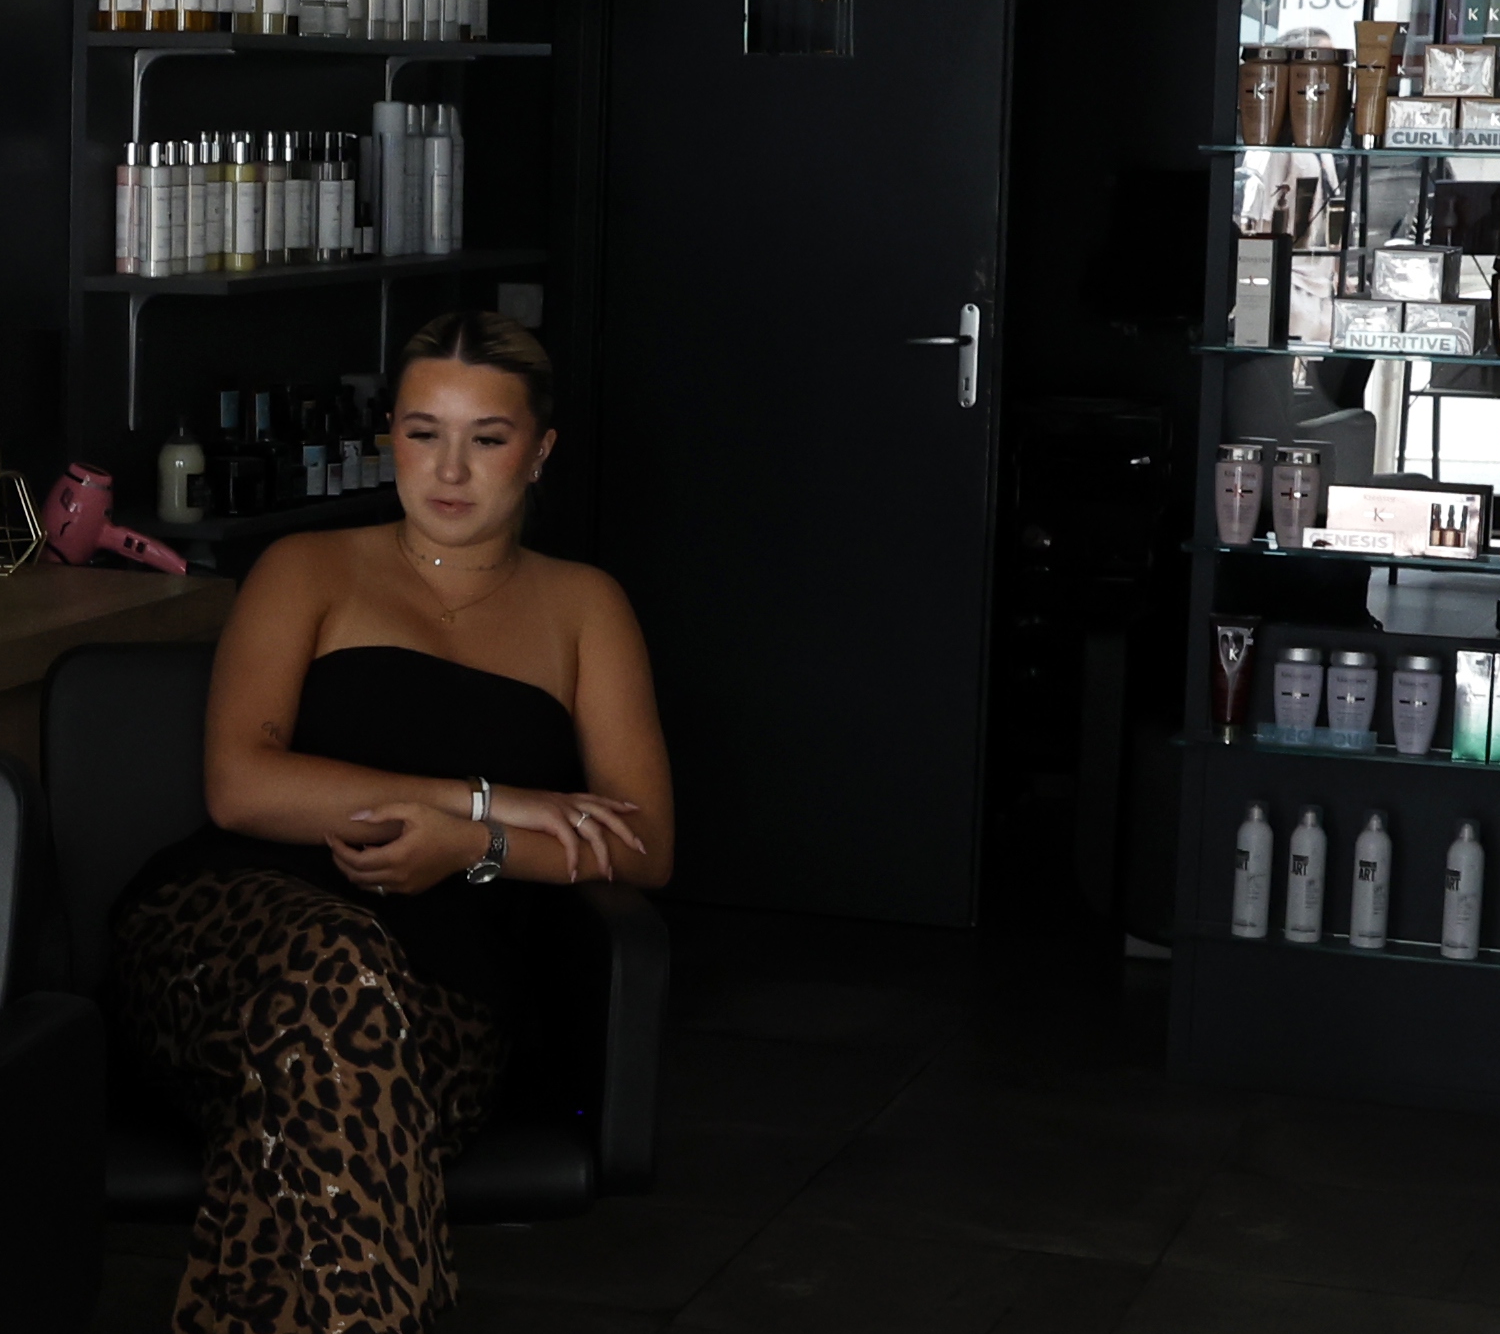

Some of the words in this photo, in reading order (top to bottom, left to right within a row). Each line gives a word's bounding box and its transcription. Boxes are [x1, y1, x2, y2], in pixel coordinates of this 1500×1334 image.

[1391, 131, 1443, 146] CURL
[1349, 333, 1451, 352] NUTRITIVE
[1373, 506, 1386, 523] K
[1308, 532, 1390, 549] GENESIS
[1358, 867, 1377, 882] ART
